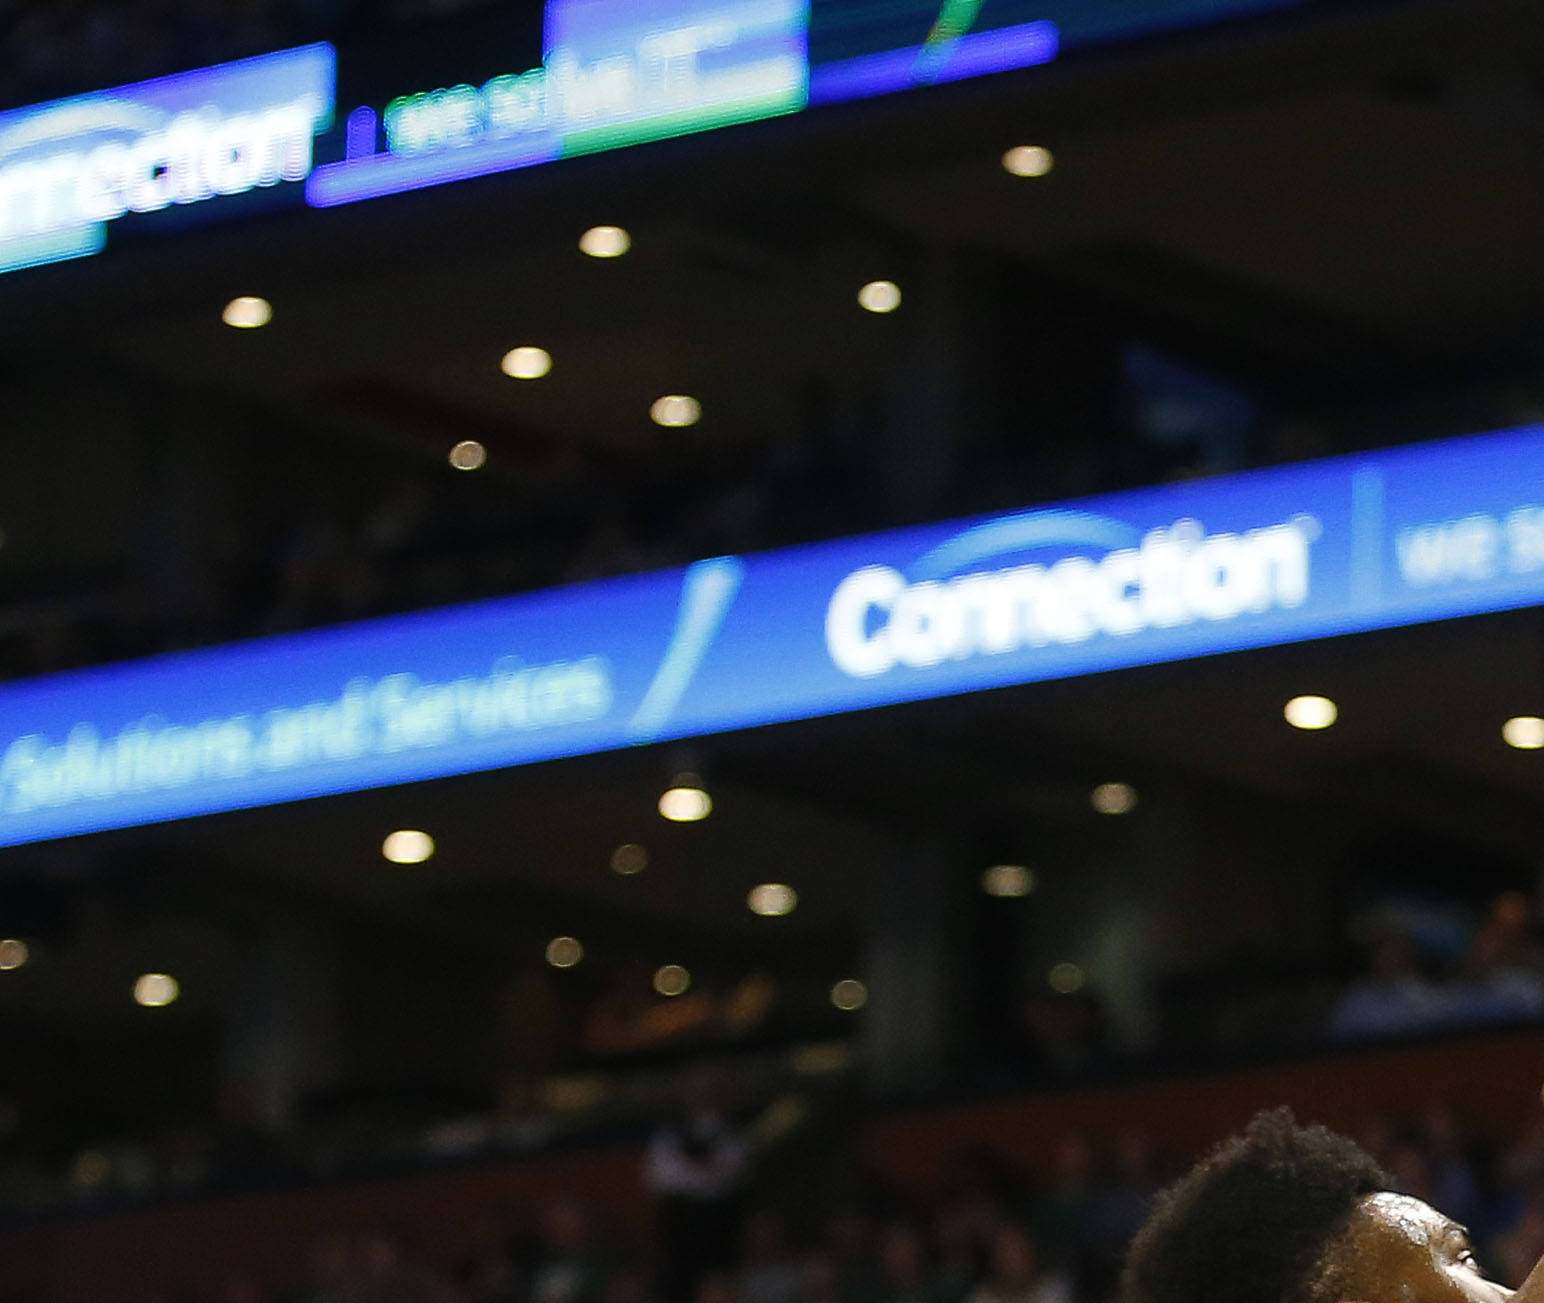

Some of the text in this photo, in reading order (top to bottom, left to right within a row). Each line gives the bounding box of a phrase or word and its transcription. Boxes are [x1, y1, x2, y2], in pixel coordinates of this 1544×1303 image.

[826, 518, 1313, 678] Connection
[1399, 513, 1498, 585] we
[2, 653, 612, 814] Solutions and Services
